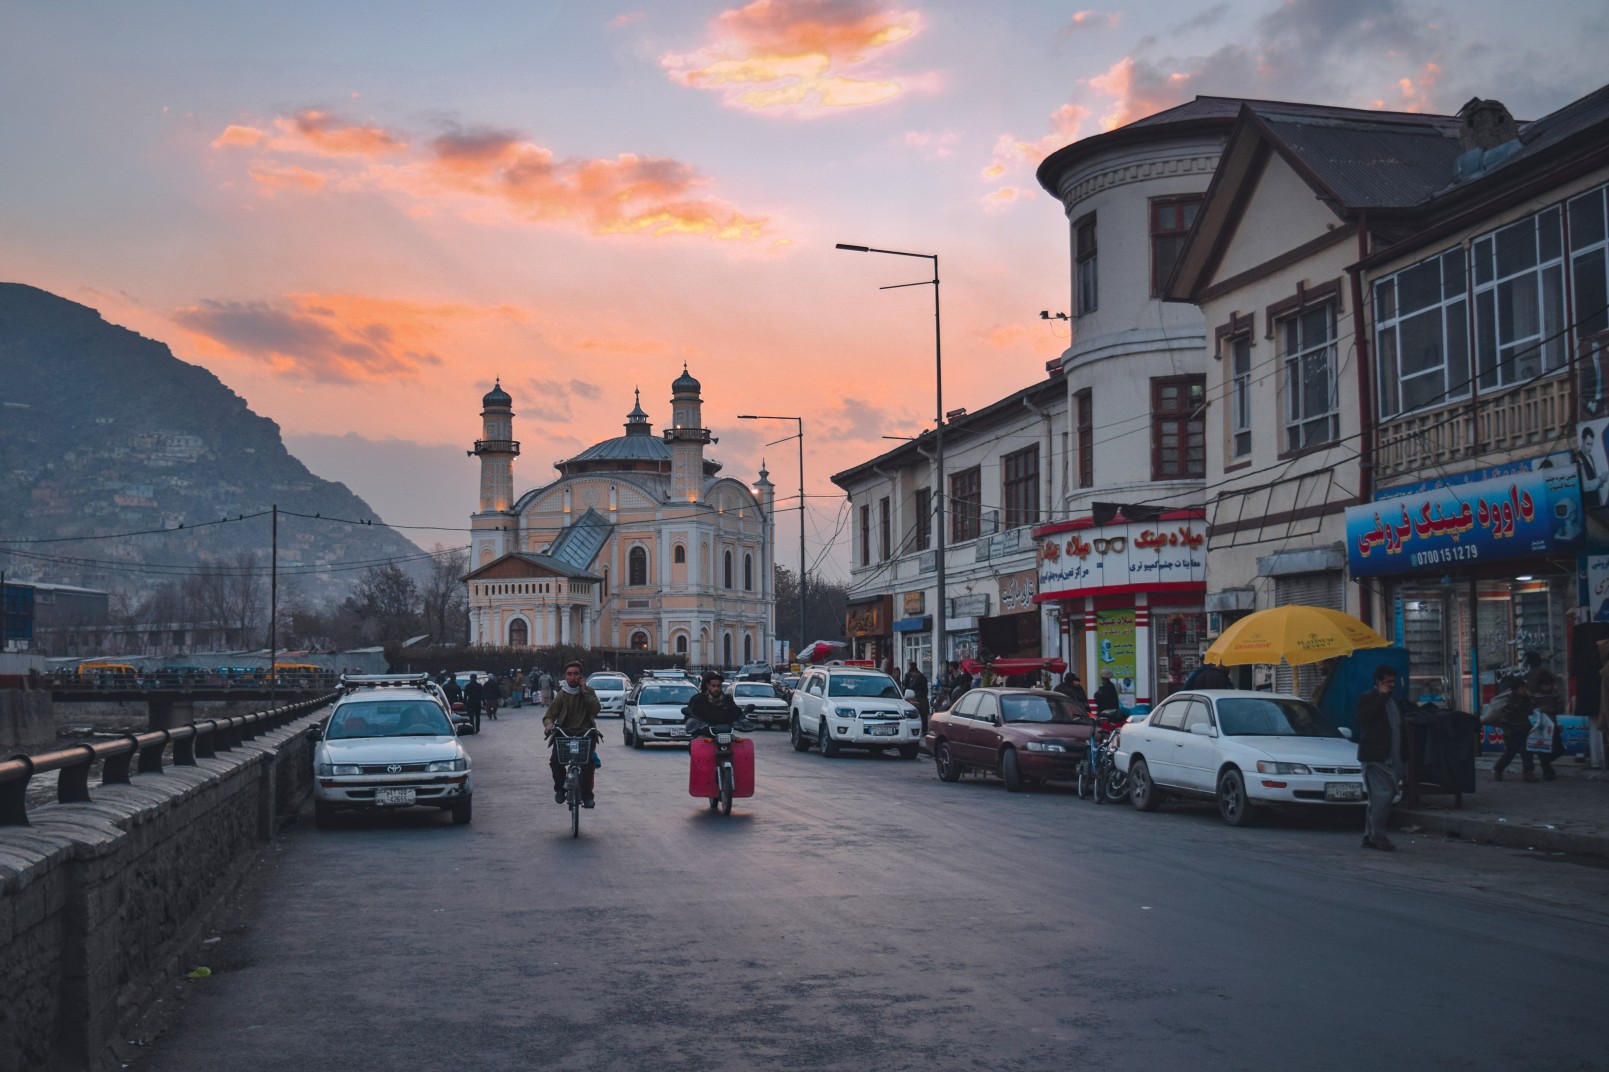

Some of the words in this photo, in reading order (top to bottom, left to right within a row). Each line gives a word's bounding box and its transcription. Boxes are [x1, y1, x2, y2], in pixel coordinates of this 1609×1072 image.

[1358, 503, 1412, 558] فروشی
[1414, 501, 1473, 542] عینک
[1478, 484, 1535, 539] داوود
[1417, 549, 1439, 566] 0700
[1440, 548, 1452, 563] 15
[1452, 547, 1465, 561] 12
[1465, 544, 1478, 559] 79
